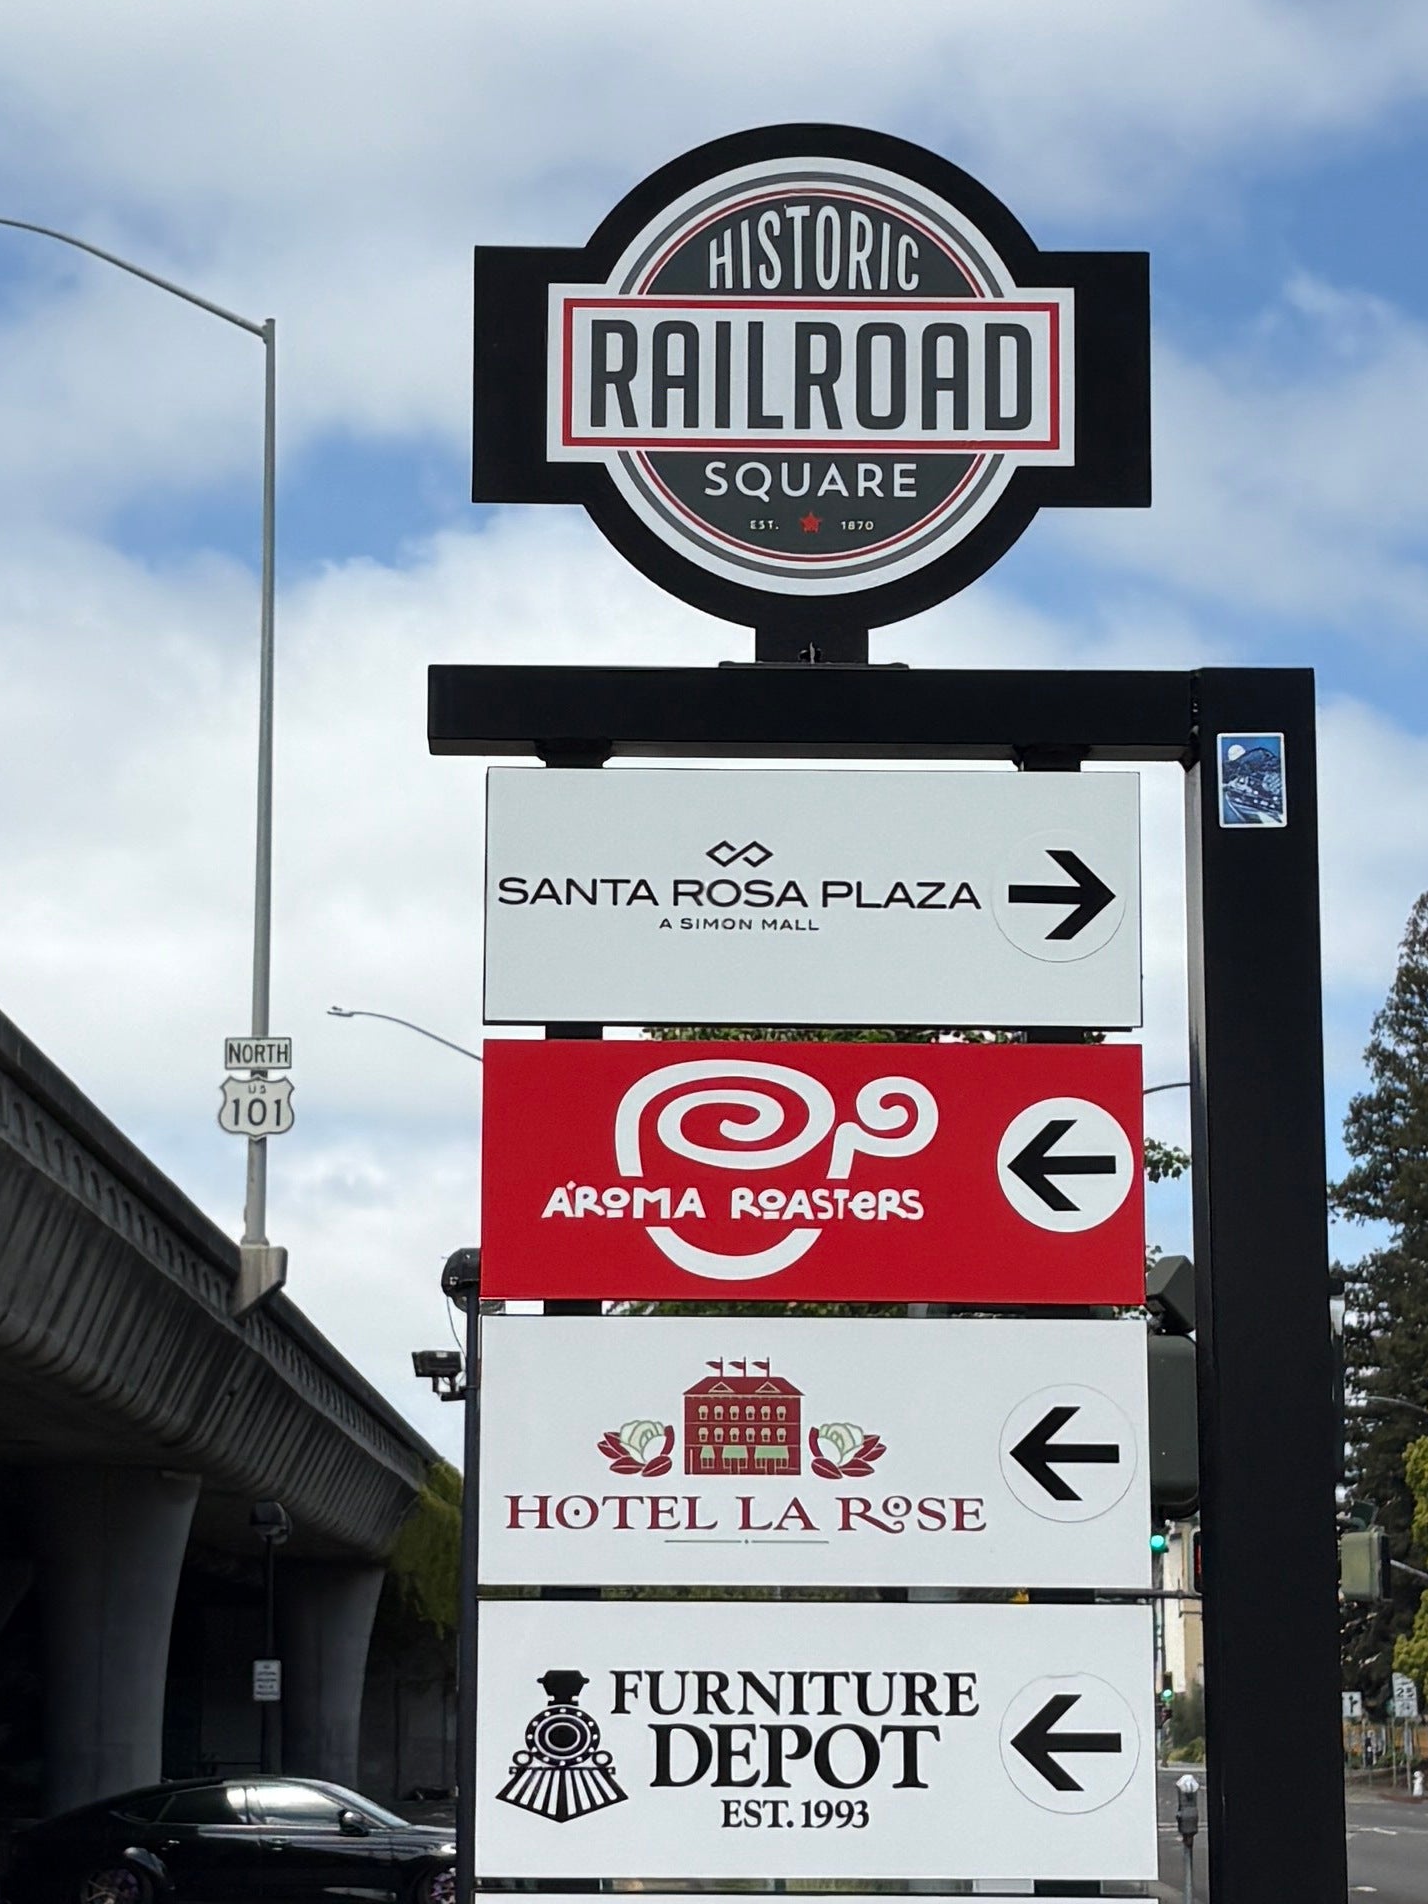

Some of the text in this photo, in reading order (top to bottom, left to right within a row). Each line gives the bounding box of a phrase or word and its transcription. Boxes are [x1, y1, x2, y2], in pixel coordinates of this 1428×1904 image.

[709, 204, 919, 292] HISTORIC
[590, 320, 1032, 431] RAILROAD
[704, 461, 917, 502] SQUARE
[750, 520, 874, 530] EST. 1870
[498, 876, 981, 910] SANTA ROSA PLAZA
[659, 917, 820, 931] A SIMON MALL
[228, 1043, 289, 1063] NORTH
[248, 1085, 266, 1094] US
[232, 1098, 282, 1126] 101
[505, 1495, 986, 1534] HOTEL LA ROSE
[611, 1670, 979, 1717] FURNITURE
[650, 1723, 940, 1790] DEPOT
[721, 1800, 870, 1829] EST. 1993
